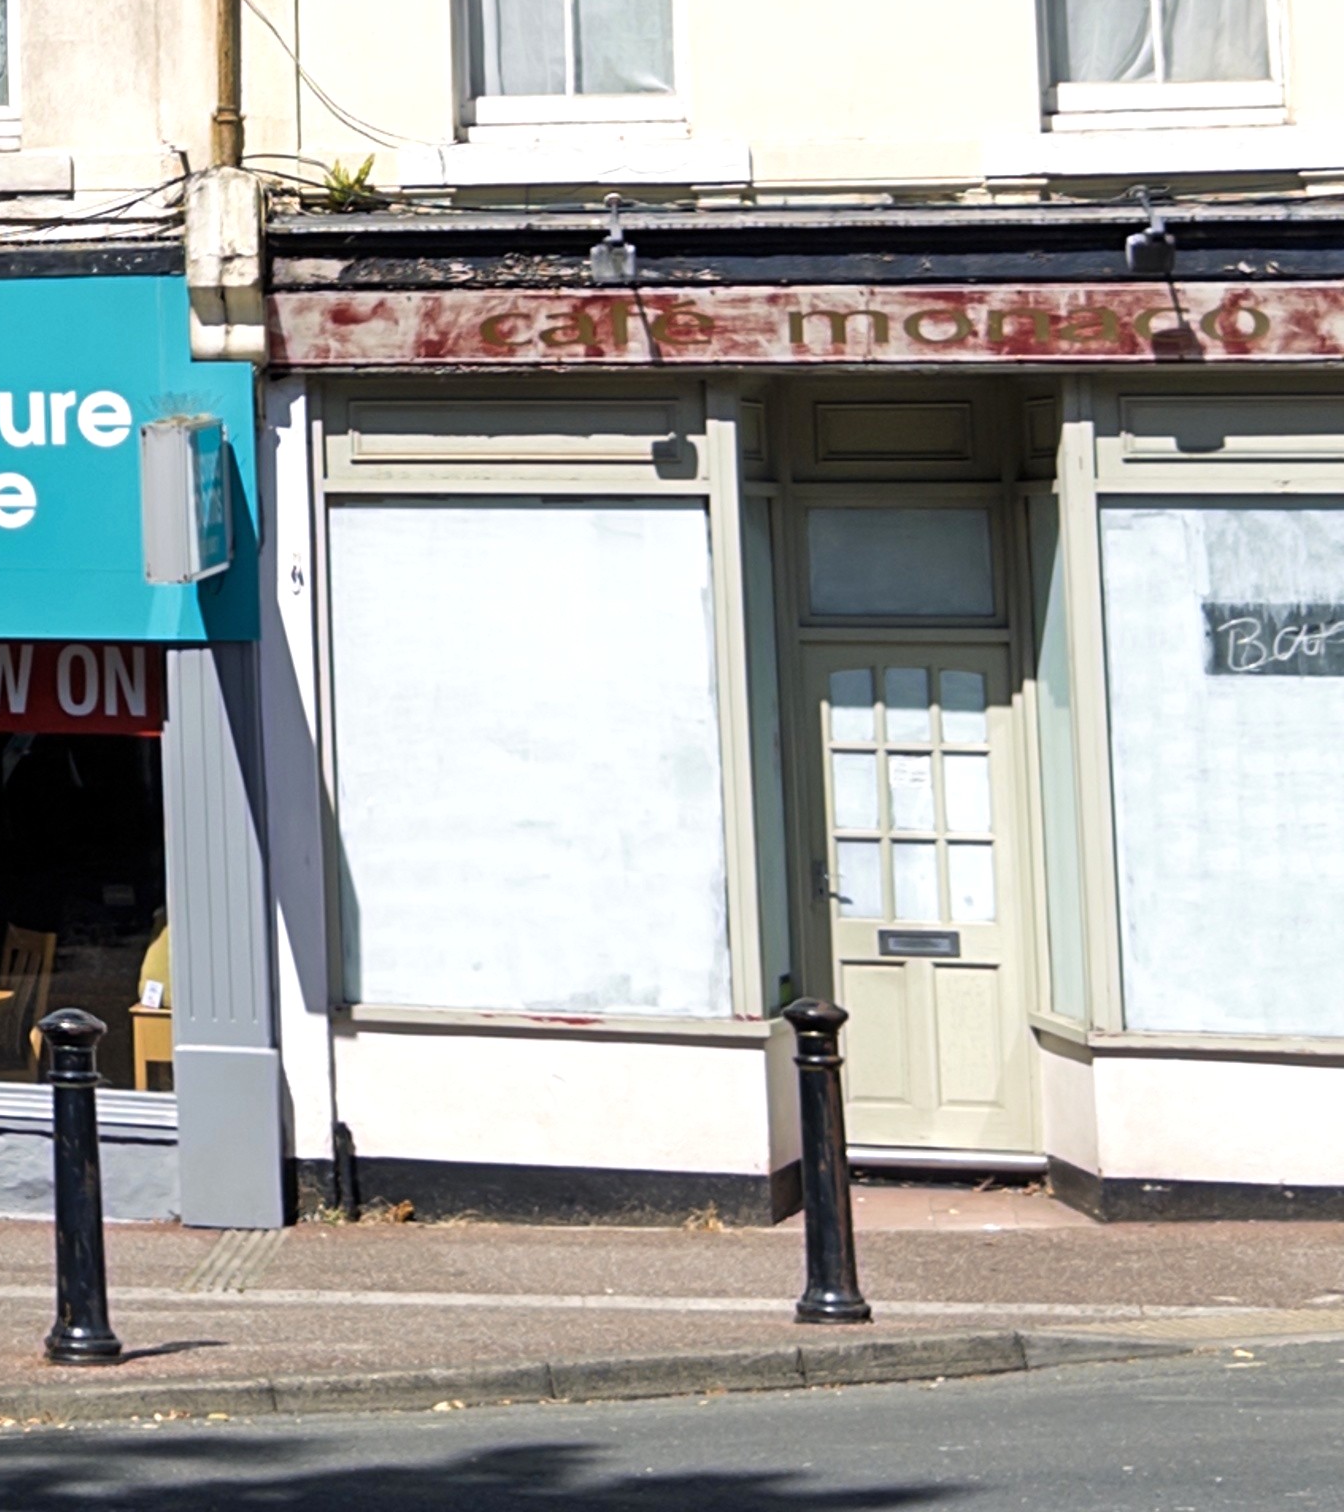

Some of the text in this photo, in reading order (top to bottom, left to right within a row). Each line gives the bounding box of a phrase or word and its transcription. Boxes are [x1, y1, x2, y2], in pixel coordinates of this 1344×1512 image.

[478, 299, 1271, 348] café monaco
[56, 644, 146, 717] ON
